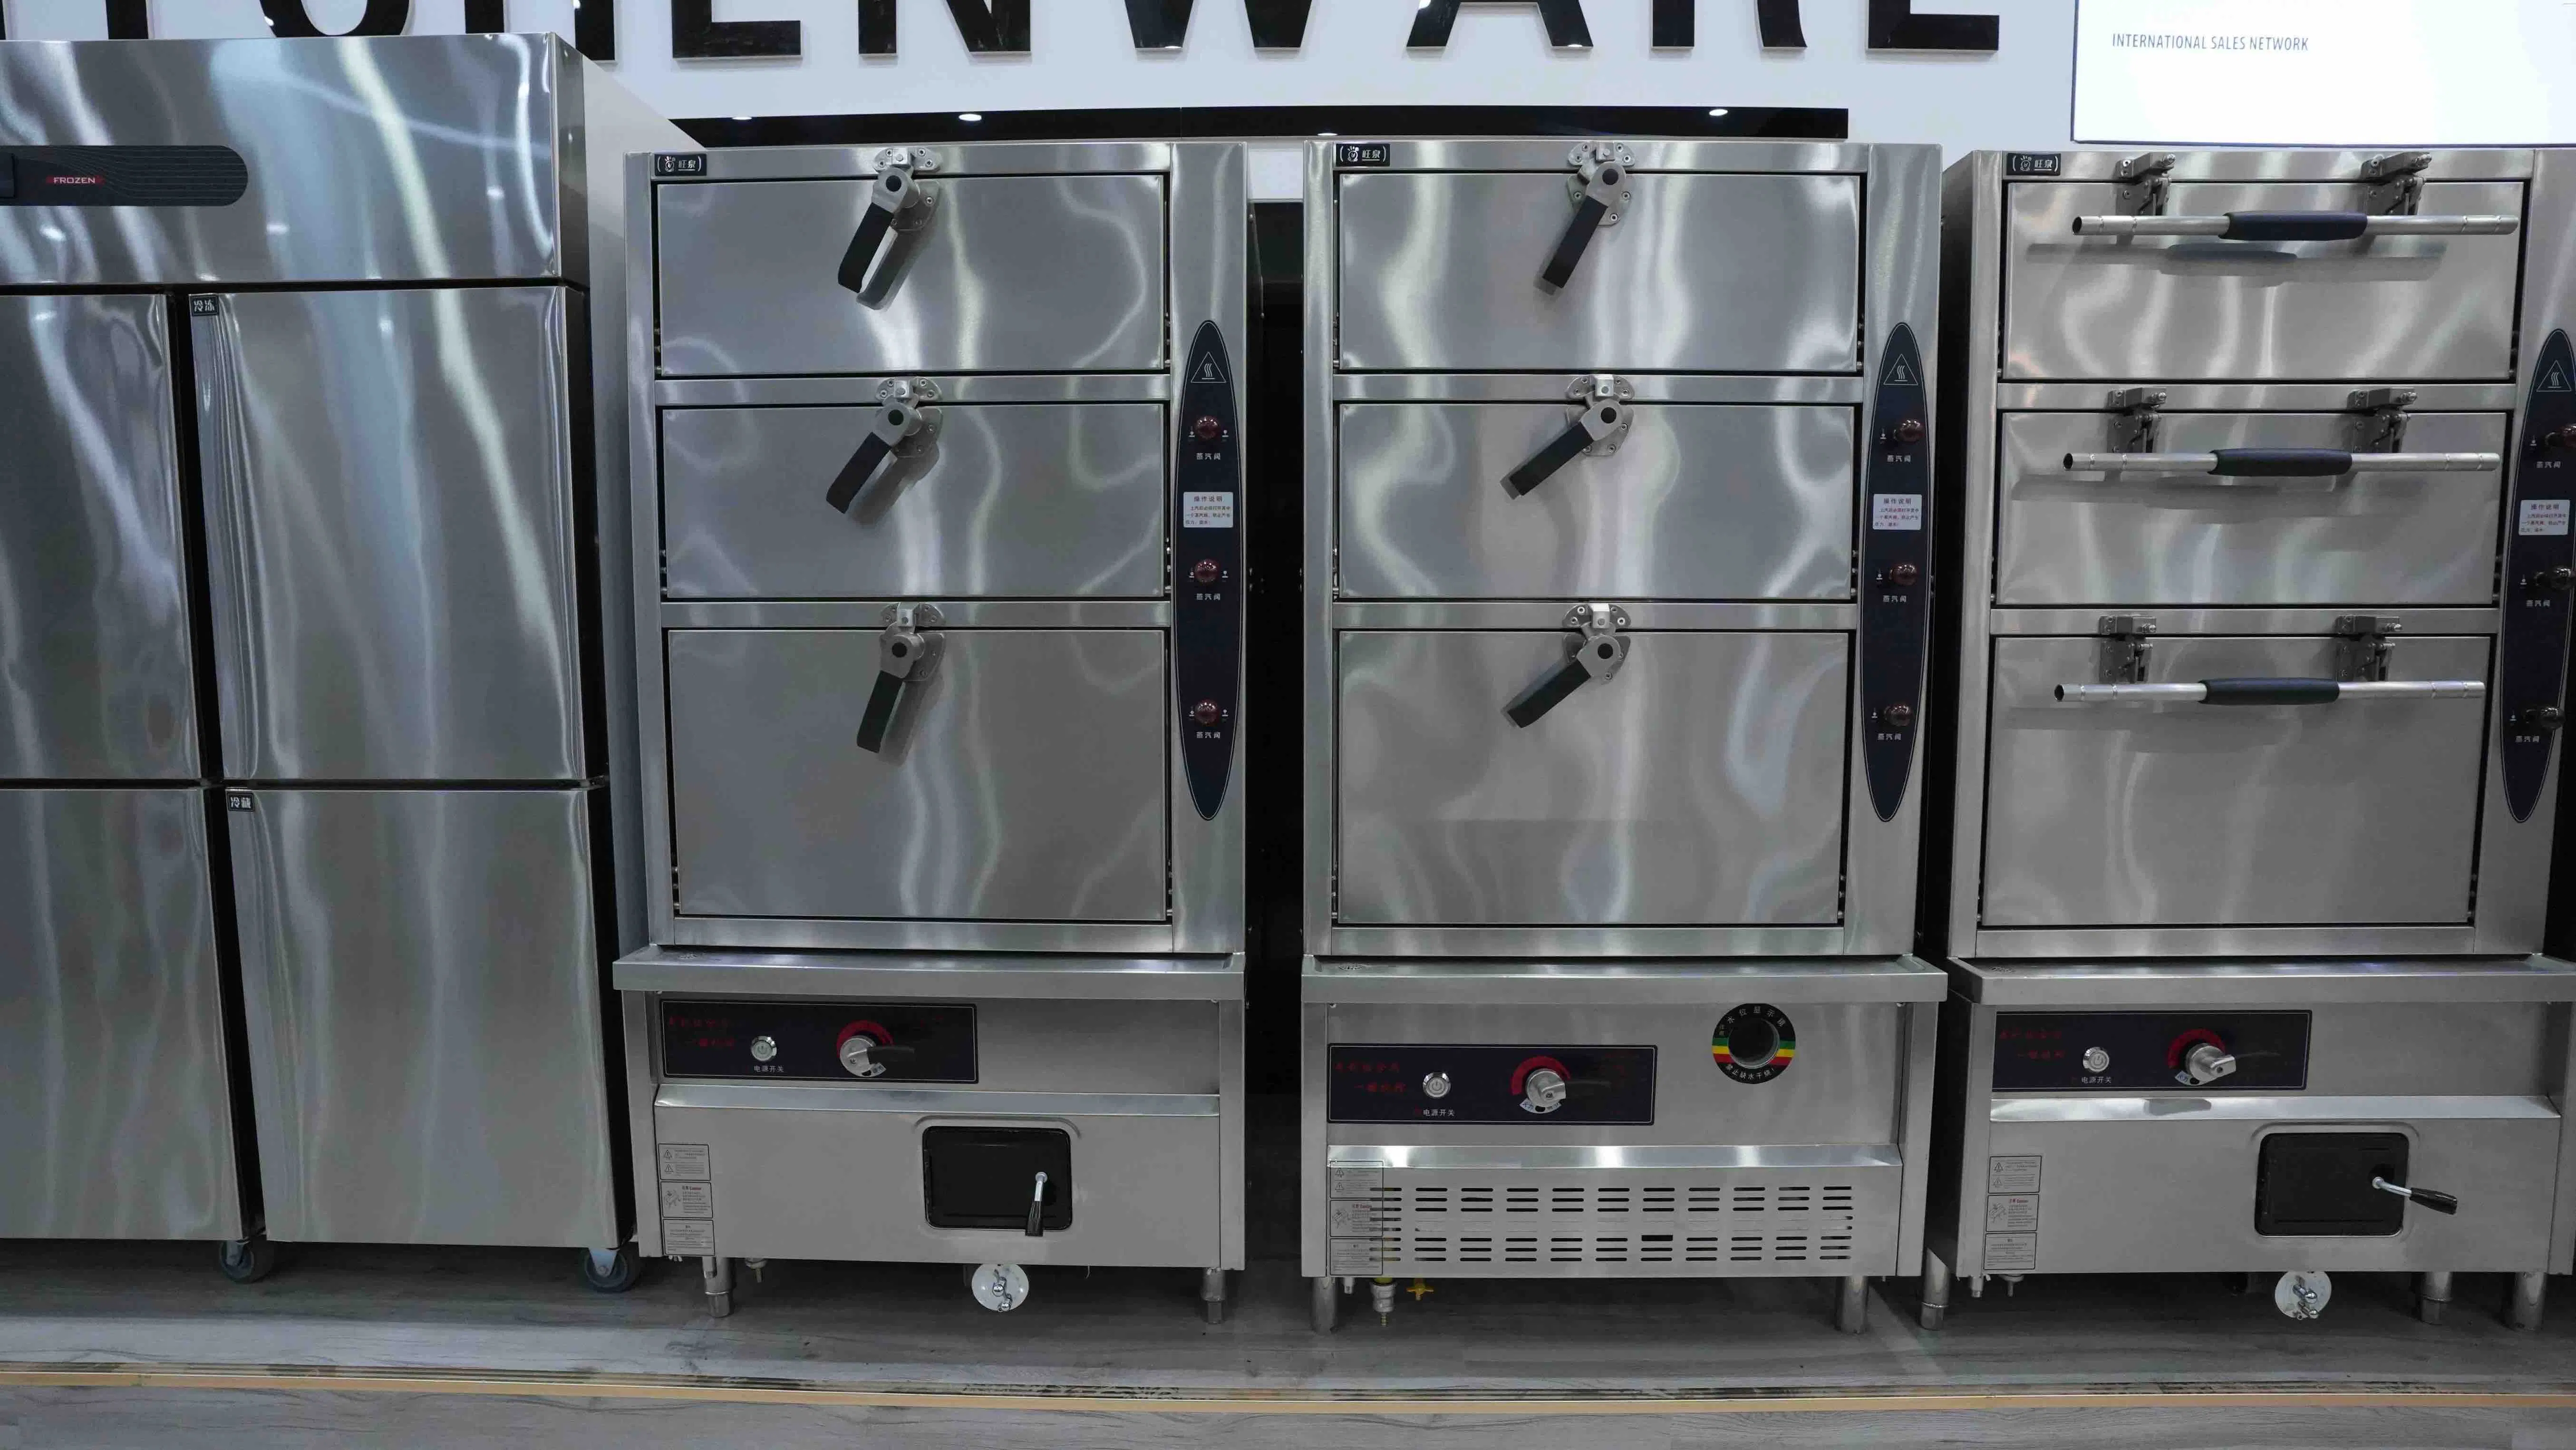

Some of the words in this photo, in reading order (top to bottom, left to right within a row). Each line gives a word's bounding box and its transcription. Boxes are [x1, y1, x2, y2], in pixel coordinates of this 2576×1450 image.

[2112, 33, 2207, 49] INTERNATIONAL
[2211, 36, 2246, 50] SALES
[2250, 37, 2309, 51] NETWORK
[1362, 149, 1381, 158] 旺泉
[2034, 159, 2053, 168] 旺泉
[194, 300, 215, 312] 冷冻
[1423, 1109, 1455, 1117] 电源开关
